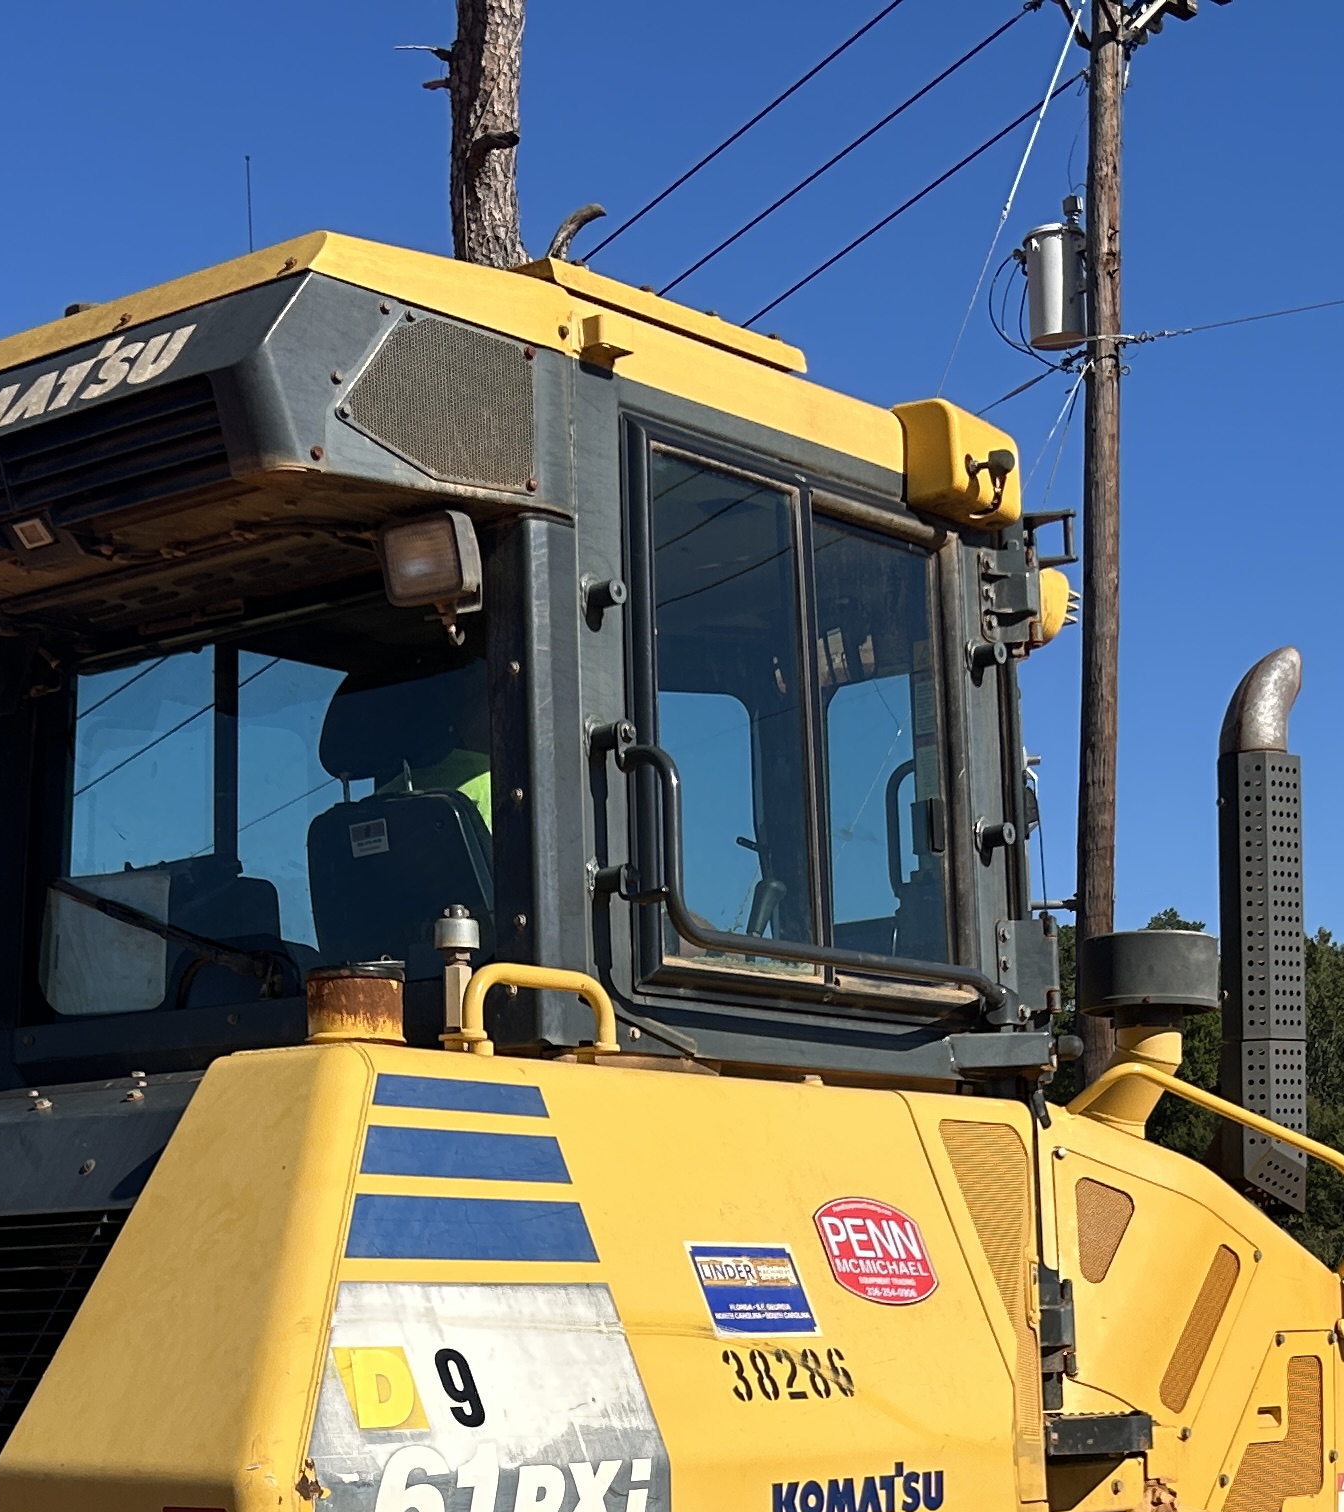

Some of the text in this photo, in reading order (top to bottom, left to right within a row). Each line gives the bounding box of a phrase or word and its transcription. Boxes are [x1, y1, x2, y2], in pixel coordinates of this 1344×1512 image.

[820, 1216, 923, 1260] PENN
[699, 1263, 755, 1280] LINDER
[834, 1258, 931, 1277] MCMICHAEL
[351, 1348, 486, 1429] D 9
[722, 1347, 855, 1402] 38286
